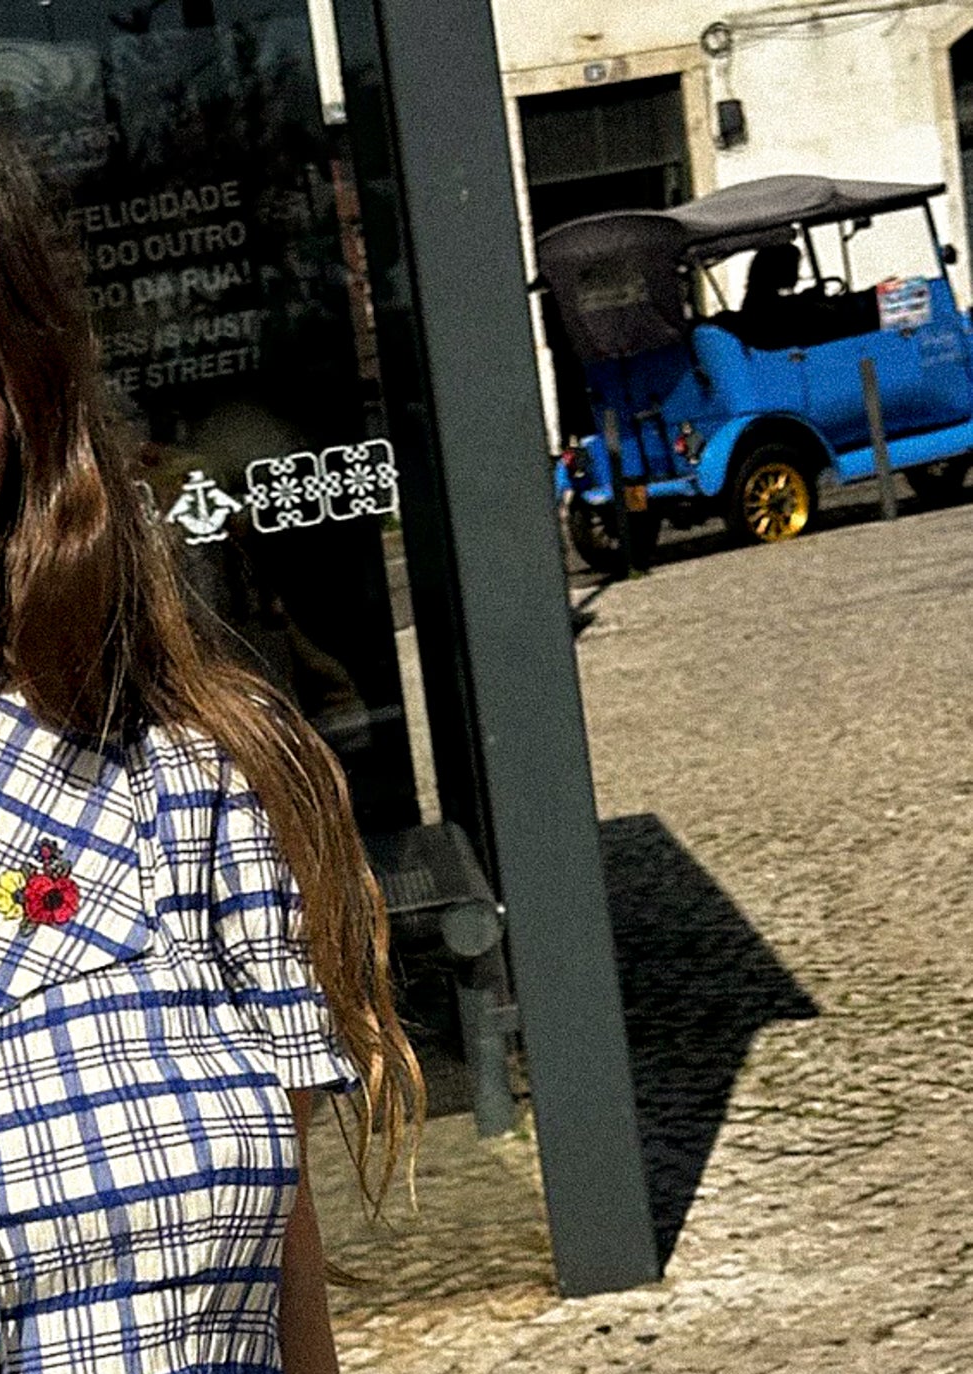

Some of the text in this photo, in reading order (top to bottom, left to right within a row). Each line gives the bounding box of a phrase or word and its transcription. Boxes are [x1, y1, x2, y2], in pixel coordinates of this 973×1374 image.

[67, 180, 241, 233] FELICIDADE
[96, 239, 140, 270] DO
[144, 220, 246, 261] OUTRO
[132, 272, 173, 303] DA
[182, 259, 250, 297] RUA!
[153, 323, 179, 351] IS
[187, 310, 256, 345] JUST
[146, 346, 260, 388] STREET!
